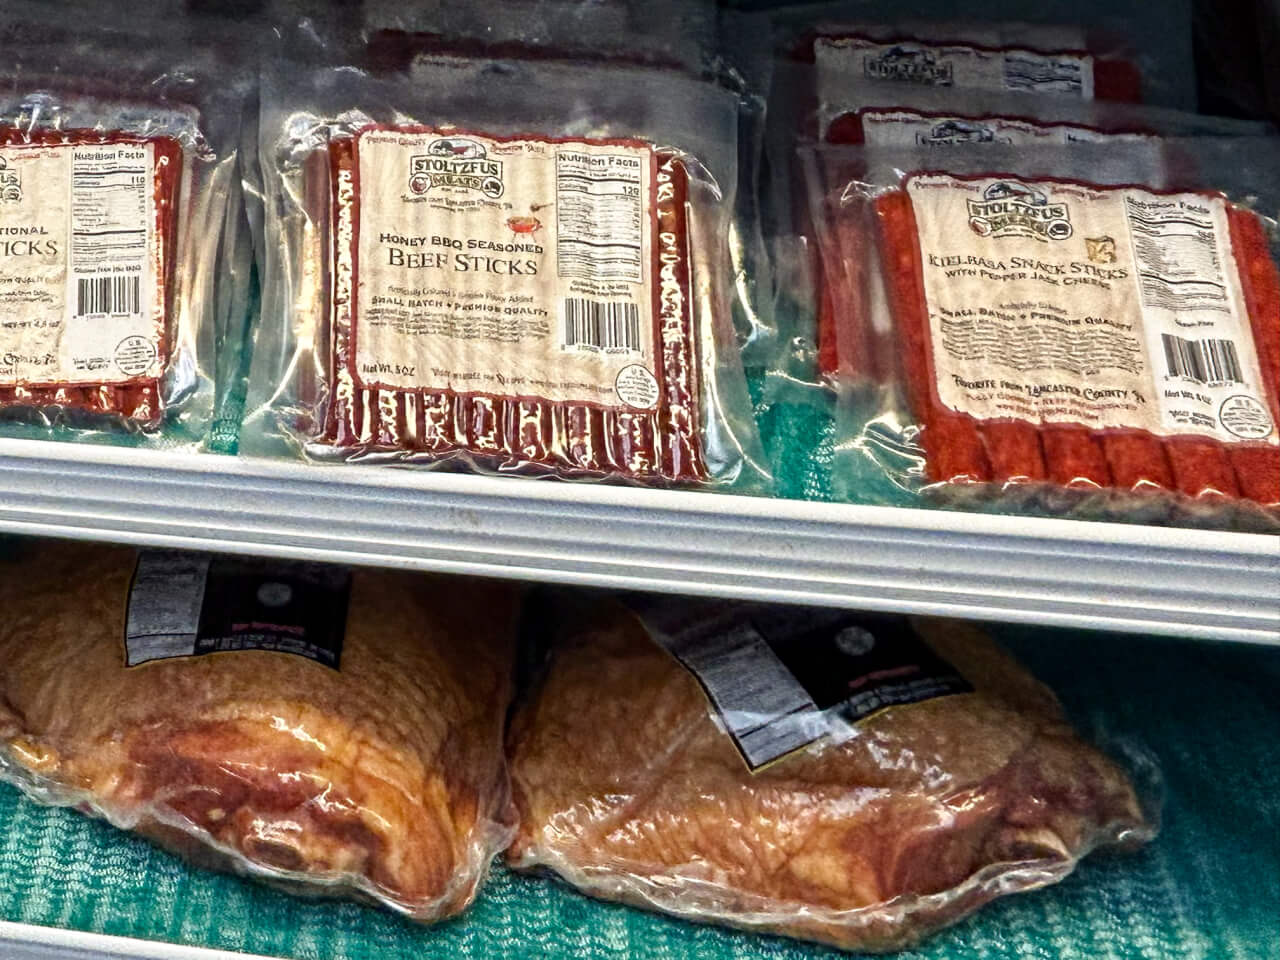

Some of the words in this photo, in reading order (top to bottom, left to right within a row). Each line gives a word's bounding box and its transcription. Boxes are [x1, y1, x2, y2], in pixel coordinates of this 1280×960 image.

[414, 157, 499, 176] STOLTZFUS
[558, 154, 606, 167] Nutrition
[379, 232, 427, 247] HONEY
[430, 235, 463, 251] BBQ
[467, 238, 544, 255] SEASONED
[388, 247, 449, 270] BEEF
[454, 253, 538, 276] STICKS
[928, 253, 1008, 271] KIELBASA
[1010, 255, 1067, 276] SNACK
[1070, 260, 1130, 280] STICKS
